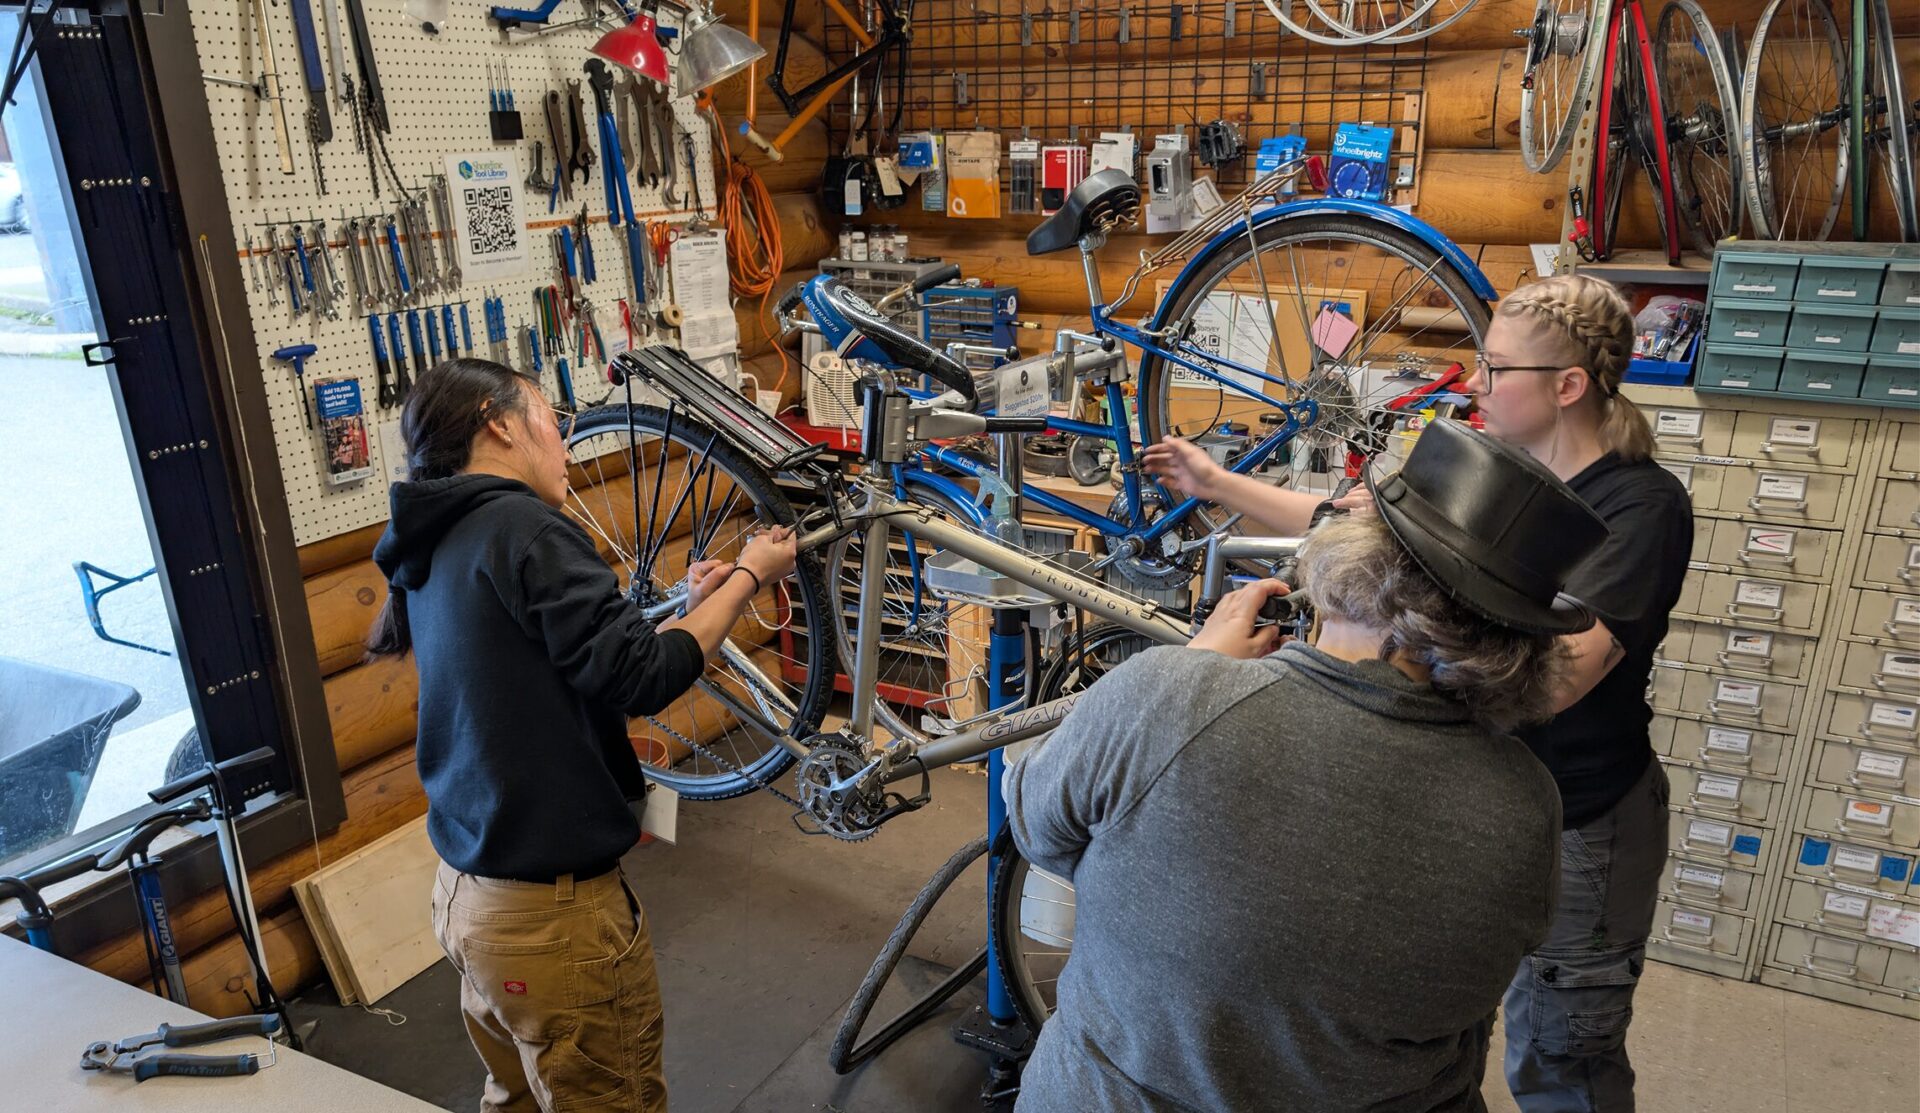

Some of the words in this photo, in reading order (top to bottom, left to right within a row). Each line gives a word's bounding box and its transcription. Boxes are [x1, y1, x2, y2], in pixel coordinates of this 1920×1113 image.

[1336, 146, 1383, 160] wheelbrightz
[472, 160, 503, 170] Shoreline
[474, 169, 487, 177] Tool
[488, 168, 508, 178] Library
[804, 294, 839, 333] BONTRAGER
[324, 387, 333, 395] Add
[342, 392, 355, 400] your
[1004, 398, 1029, 411] Suggested
[1027, 404, 1048, 416] Donation
[1031, 567, 1133, 616] PRODIGY
[979, 694, 1084, 742] GIAN
[152, 899, 171, 945] GIANT
[167, 1063, 228, 1075] ParkTool
